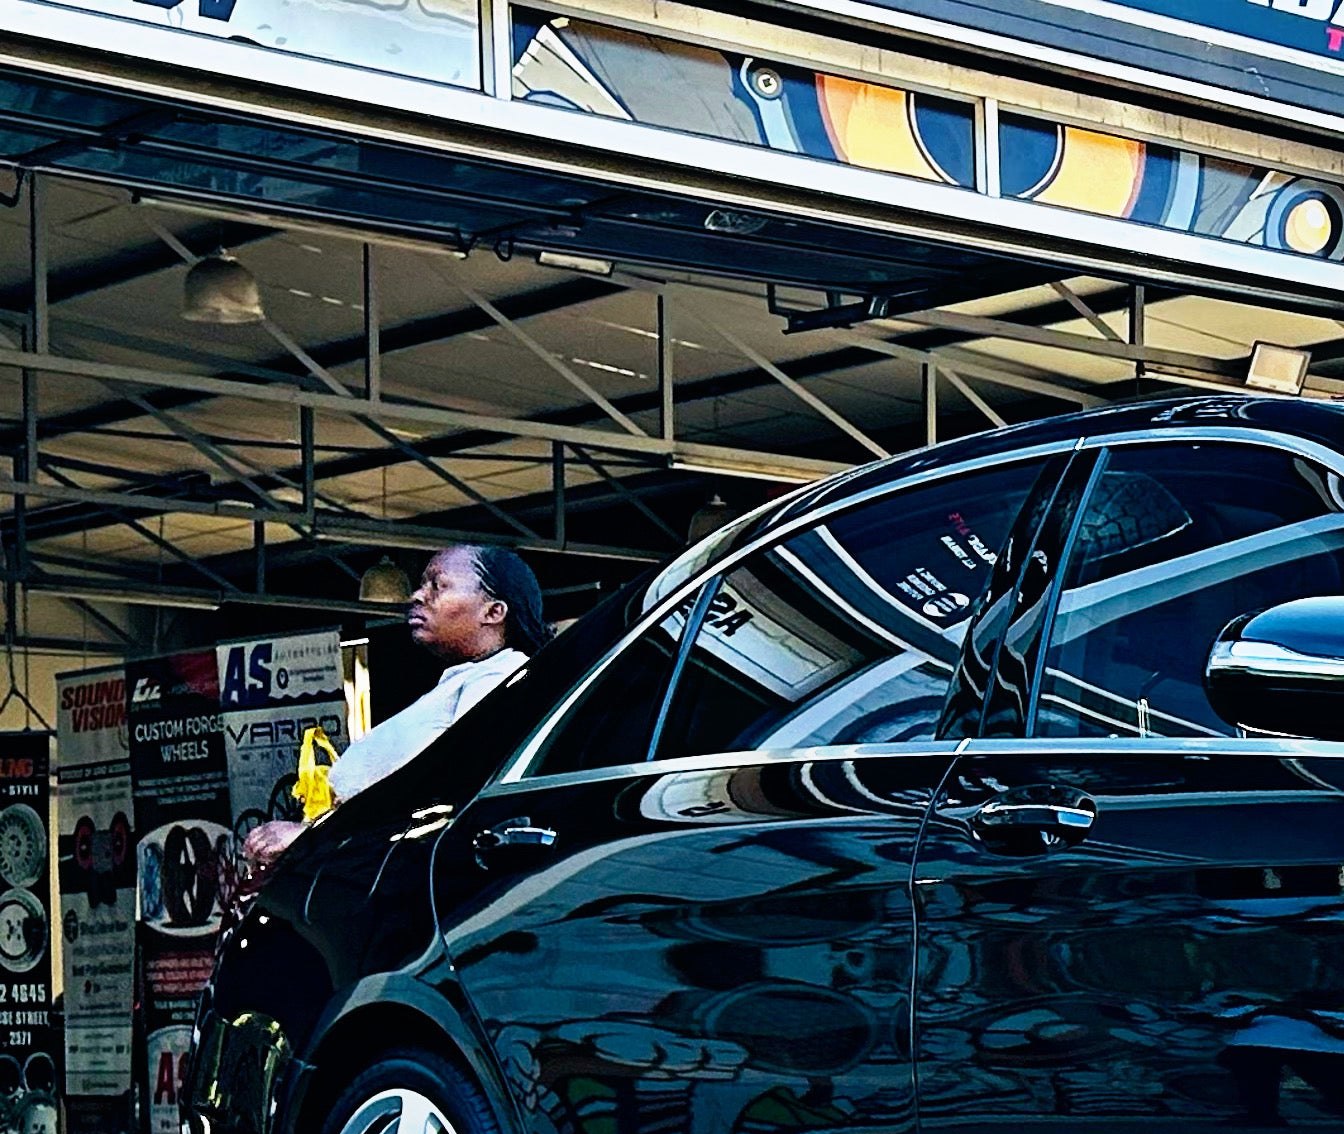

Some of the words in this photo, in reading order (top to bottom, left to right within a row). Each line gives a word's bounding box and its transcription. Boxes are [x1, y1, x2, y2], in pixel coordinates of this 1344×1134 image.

[222, 643, 273, 703] AS
[61, 678, 125, 710] SOUND
[72, 703, 127, 733] VISION
[135, 719, 183, 742] CUSTOM
[160, 740, 209, 762] WHEELS
